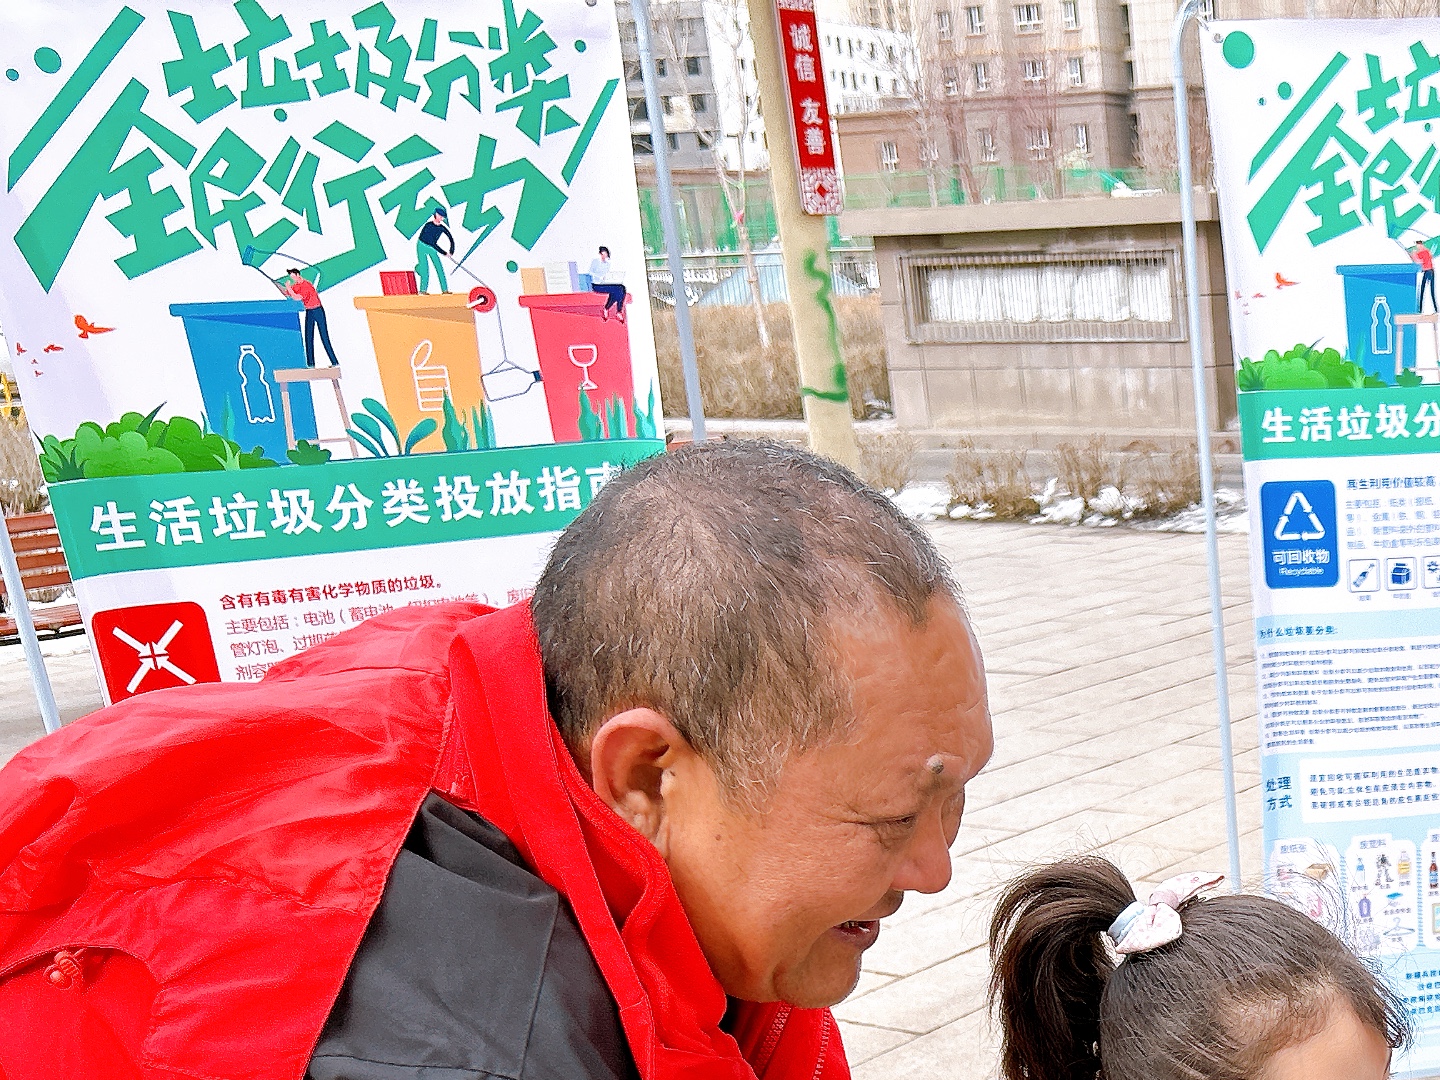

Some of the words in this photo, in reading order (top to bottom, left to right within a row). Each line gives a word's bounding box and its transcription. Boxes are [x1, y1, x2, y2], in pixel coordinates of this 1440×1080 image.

[161, 0, 579, 145] 垃圾分类
[800, 98, 826, 155] 友善
[14, 79, 568, 293] 全民行动
[1271, 549, 1331, 566] 可回收物
